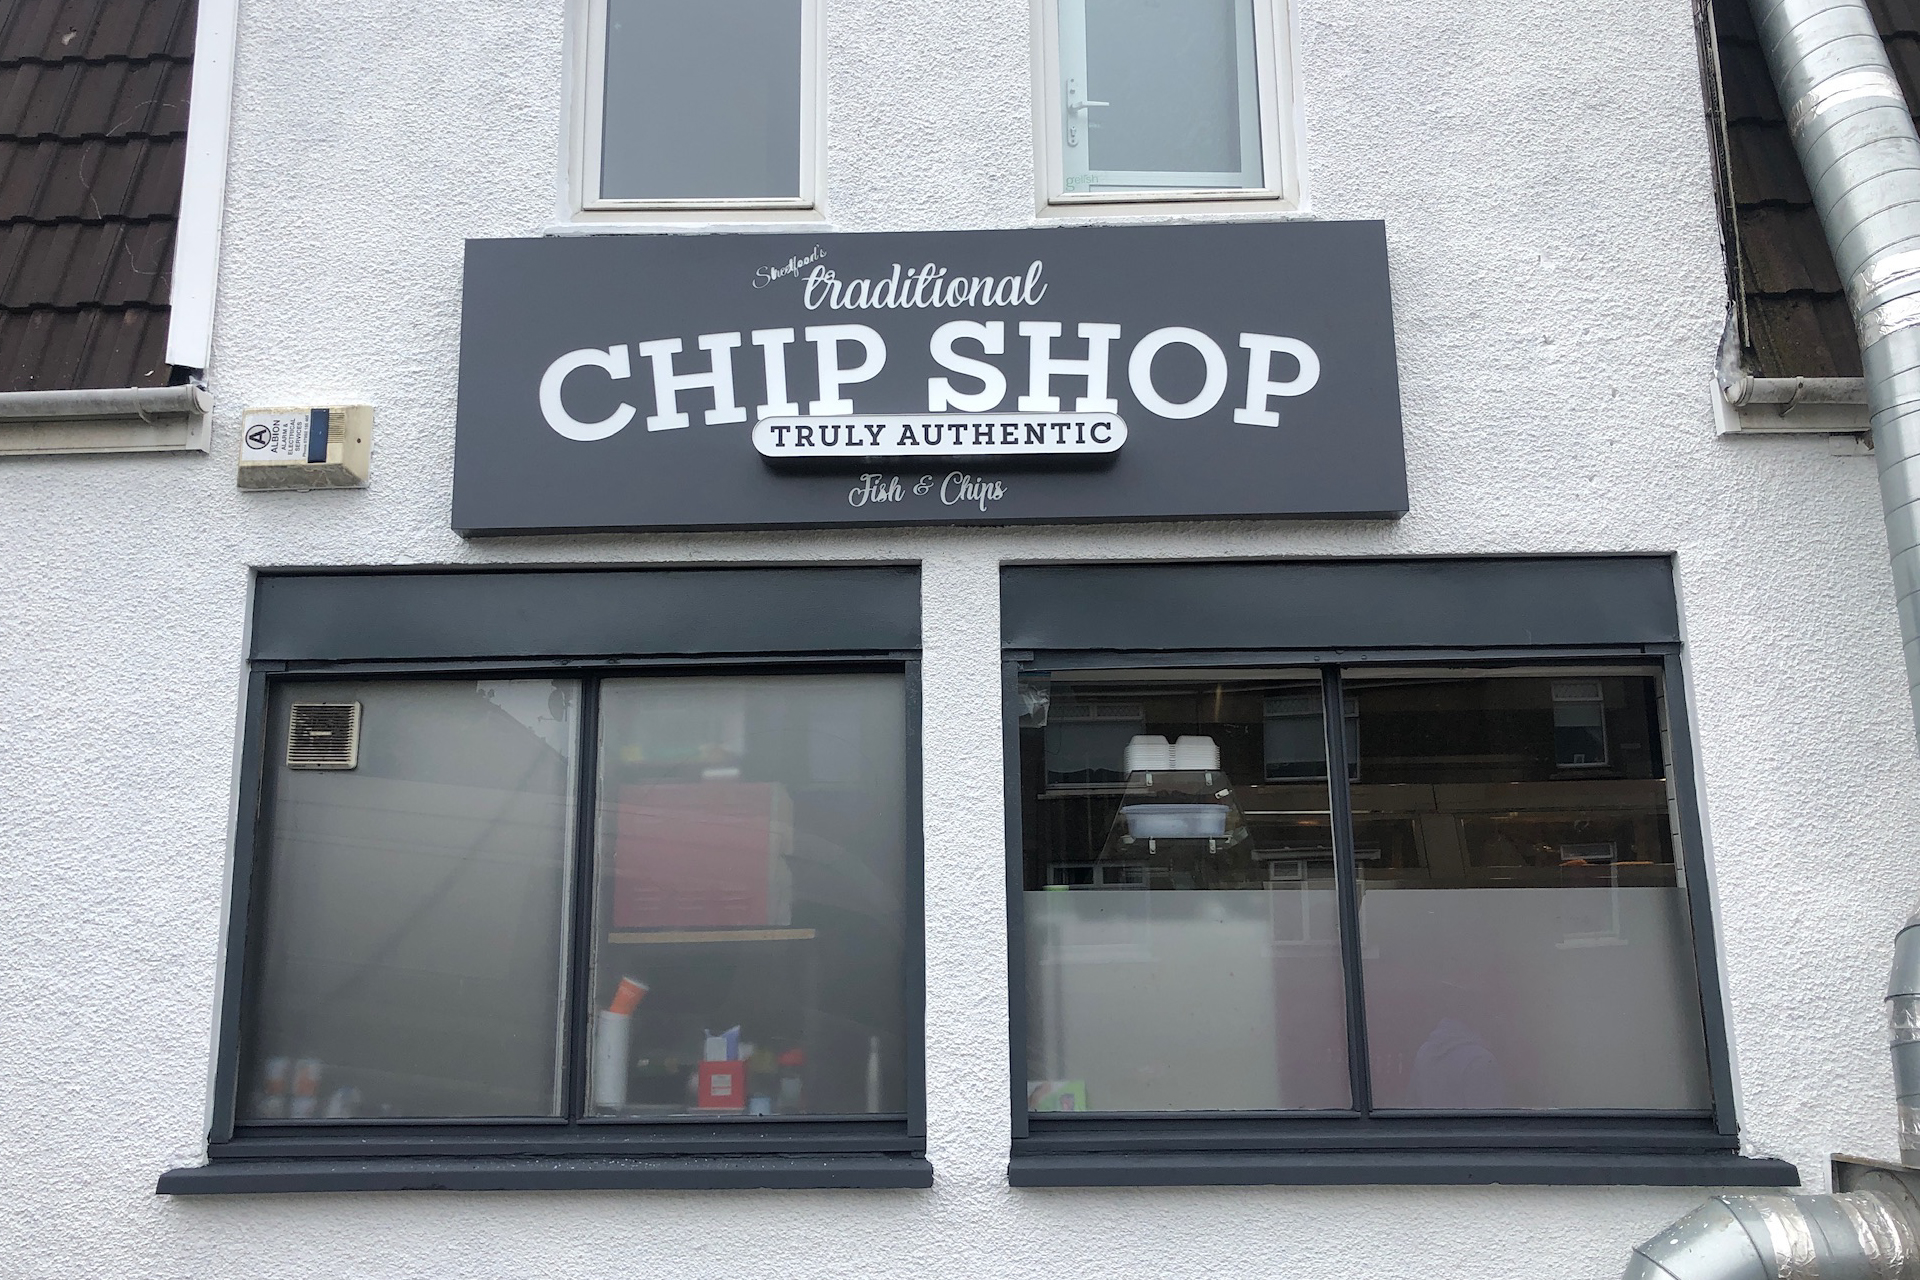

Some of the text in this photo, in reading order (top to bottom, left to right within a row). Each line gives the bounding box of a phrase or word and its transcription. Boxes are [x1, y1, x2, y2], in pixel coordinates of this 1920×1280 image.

[801, 260, 1048, 310] traditional
[539, 320, 1321, 442] CHIP SHOP
[270, 419, 280, 453] ALBION
[288, 418, 296, 455] ELECTRICAL
[295, 421, 303, 452] SERVICES
[770, 422, 1112, 447] TRULY AUTHENTIC
[848, 471, 1008, 512] Fish & Chips
